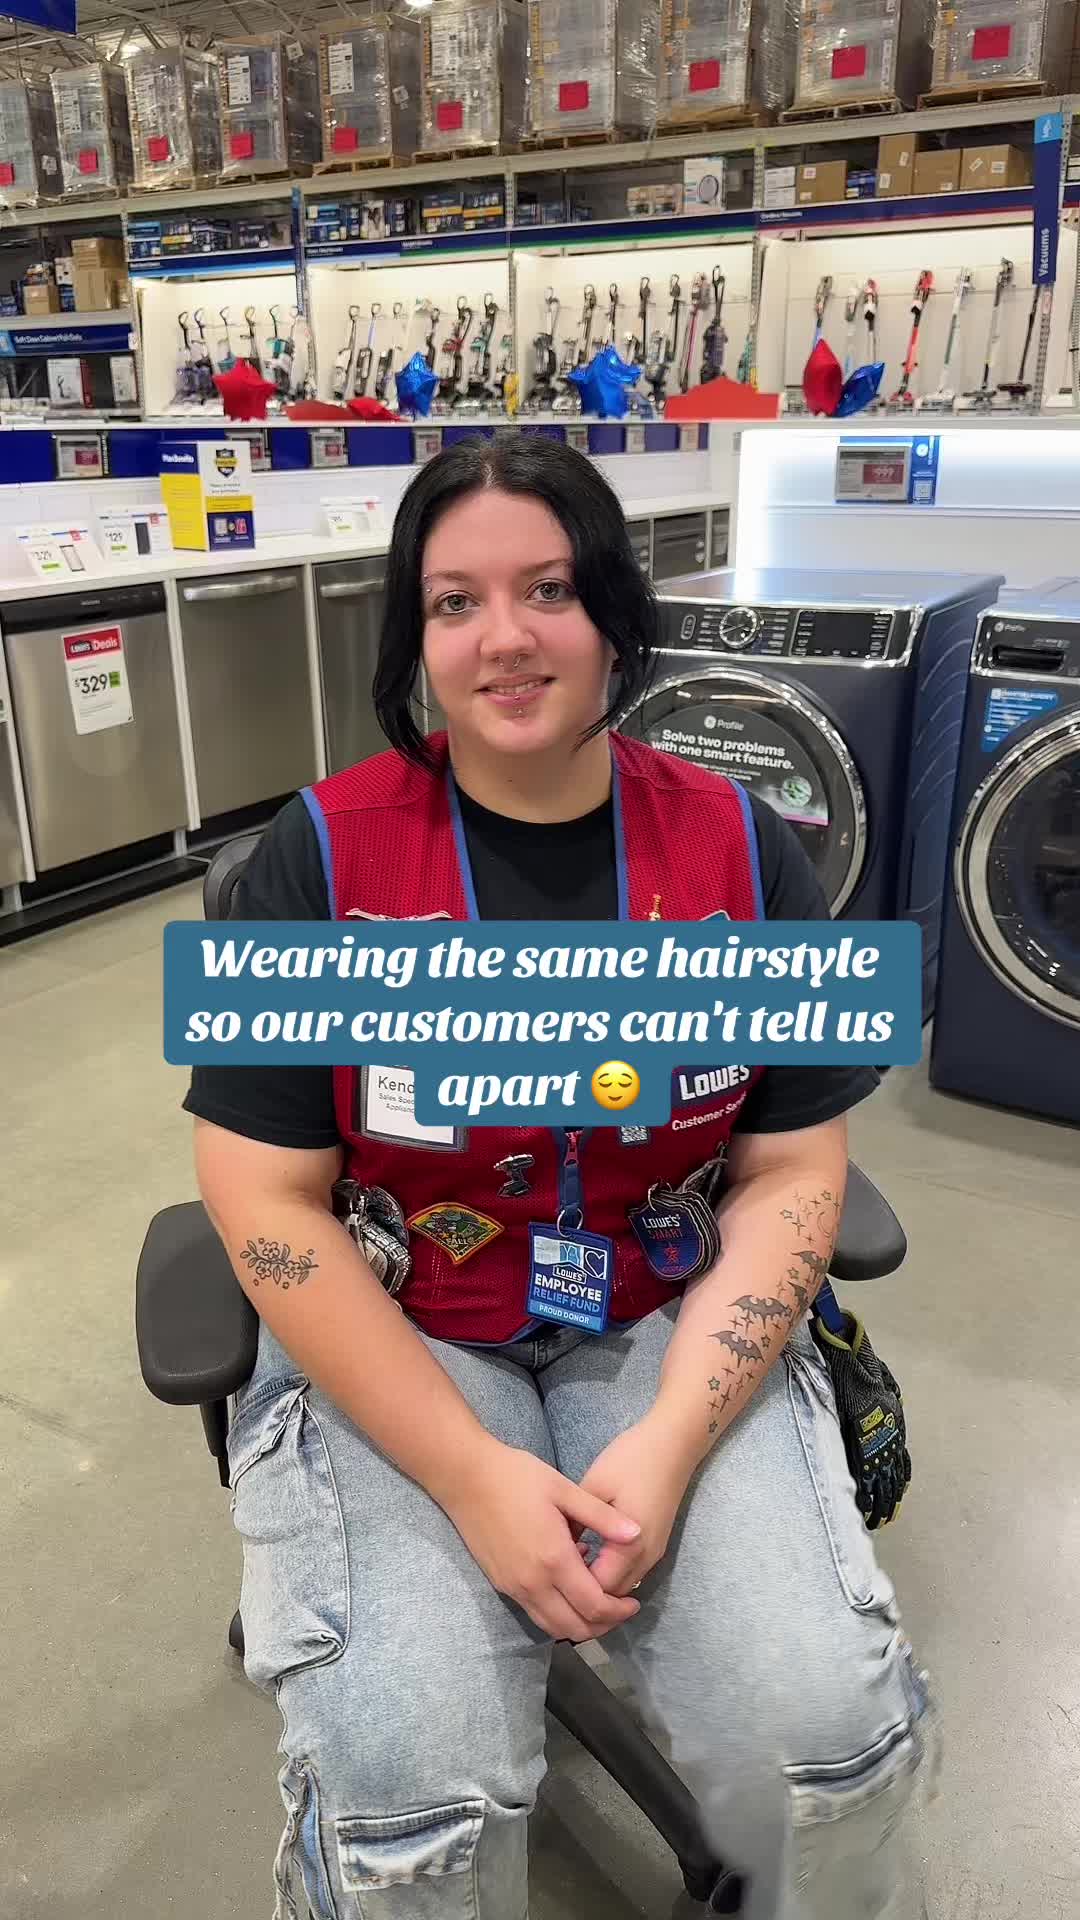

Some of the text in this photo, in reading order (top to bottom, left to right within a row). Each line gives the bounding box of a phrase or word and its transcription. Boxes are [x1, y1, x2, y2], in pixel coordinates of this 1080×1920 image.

[1037, 228, 1051, 278] Vacuums
[92, 637, 118, 651] Deals
[717, 719, 745, 731] Profile
[662, 729, 785, 757] Solve two problems
[651, 740, 678, 753] with
[678, 745, 702, 757] one
[703, 748, 742, 763] smart
[743, 752, 795, 770] feature.
[671, 1109, 725, 1132] Customer
[642, 1214, 681, 1229] LOWE'S
[555, 1267, 584, 1282] LOWE'S
[534, 1273, 602, 1302] EMPLOYEE
[533, 1287, 600, 1313] RELIEF FUND
[539, 1304, 590, 1325] PROUD DONOR
